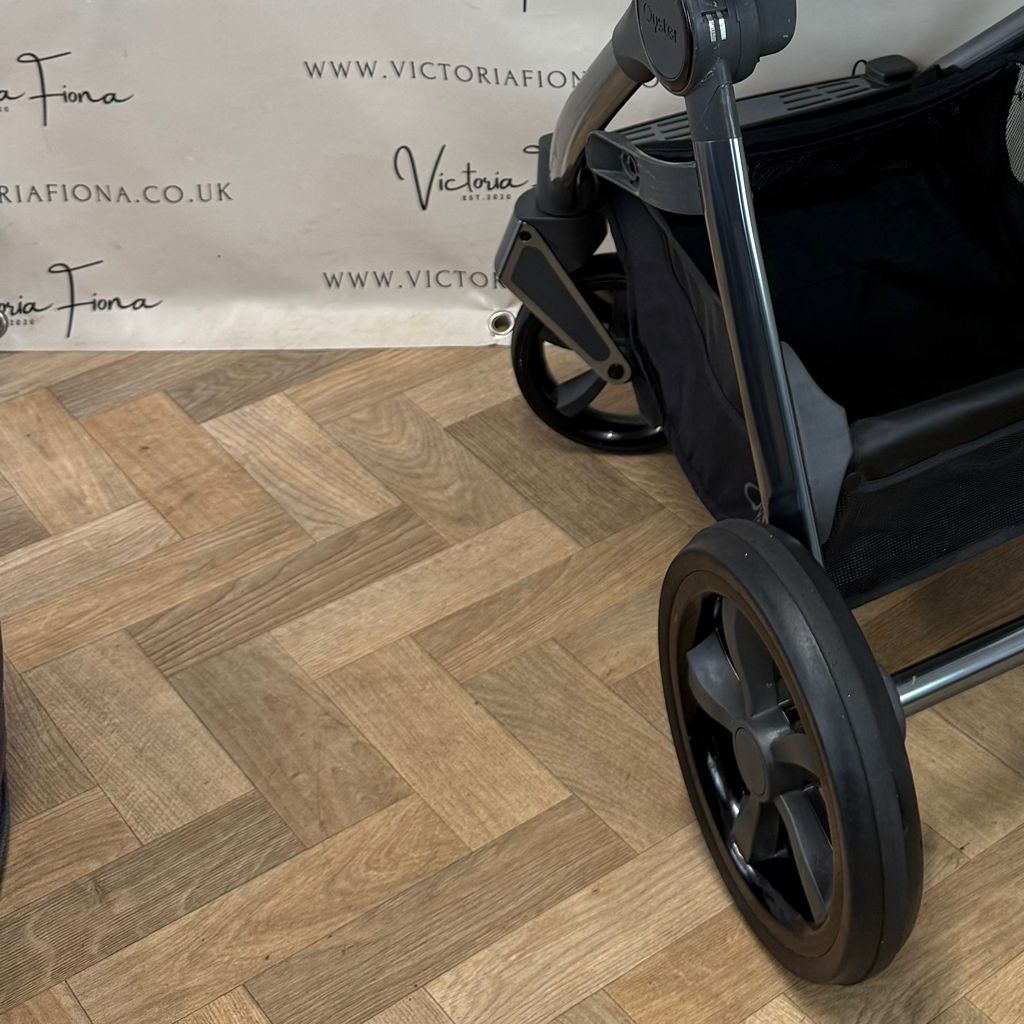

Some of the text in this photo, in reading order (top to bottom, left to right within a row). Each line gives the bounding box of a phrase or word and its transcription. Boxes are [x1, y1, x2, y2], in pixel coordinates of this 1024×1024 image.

[643, 2, 677, 43] Oyster
[16, 51, 135, 127] Fiona
[394, 144, 529, 211] Victoria
[462, 193, 512, 202] EST.2020
[48, 260, 163, 338] Fiona
